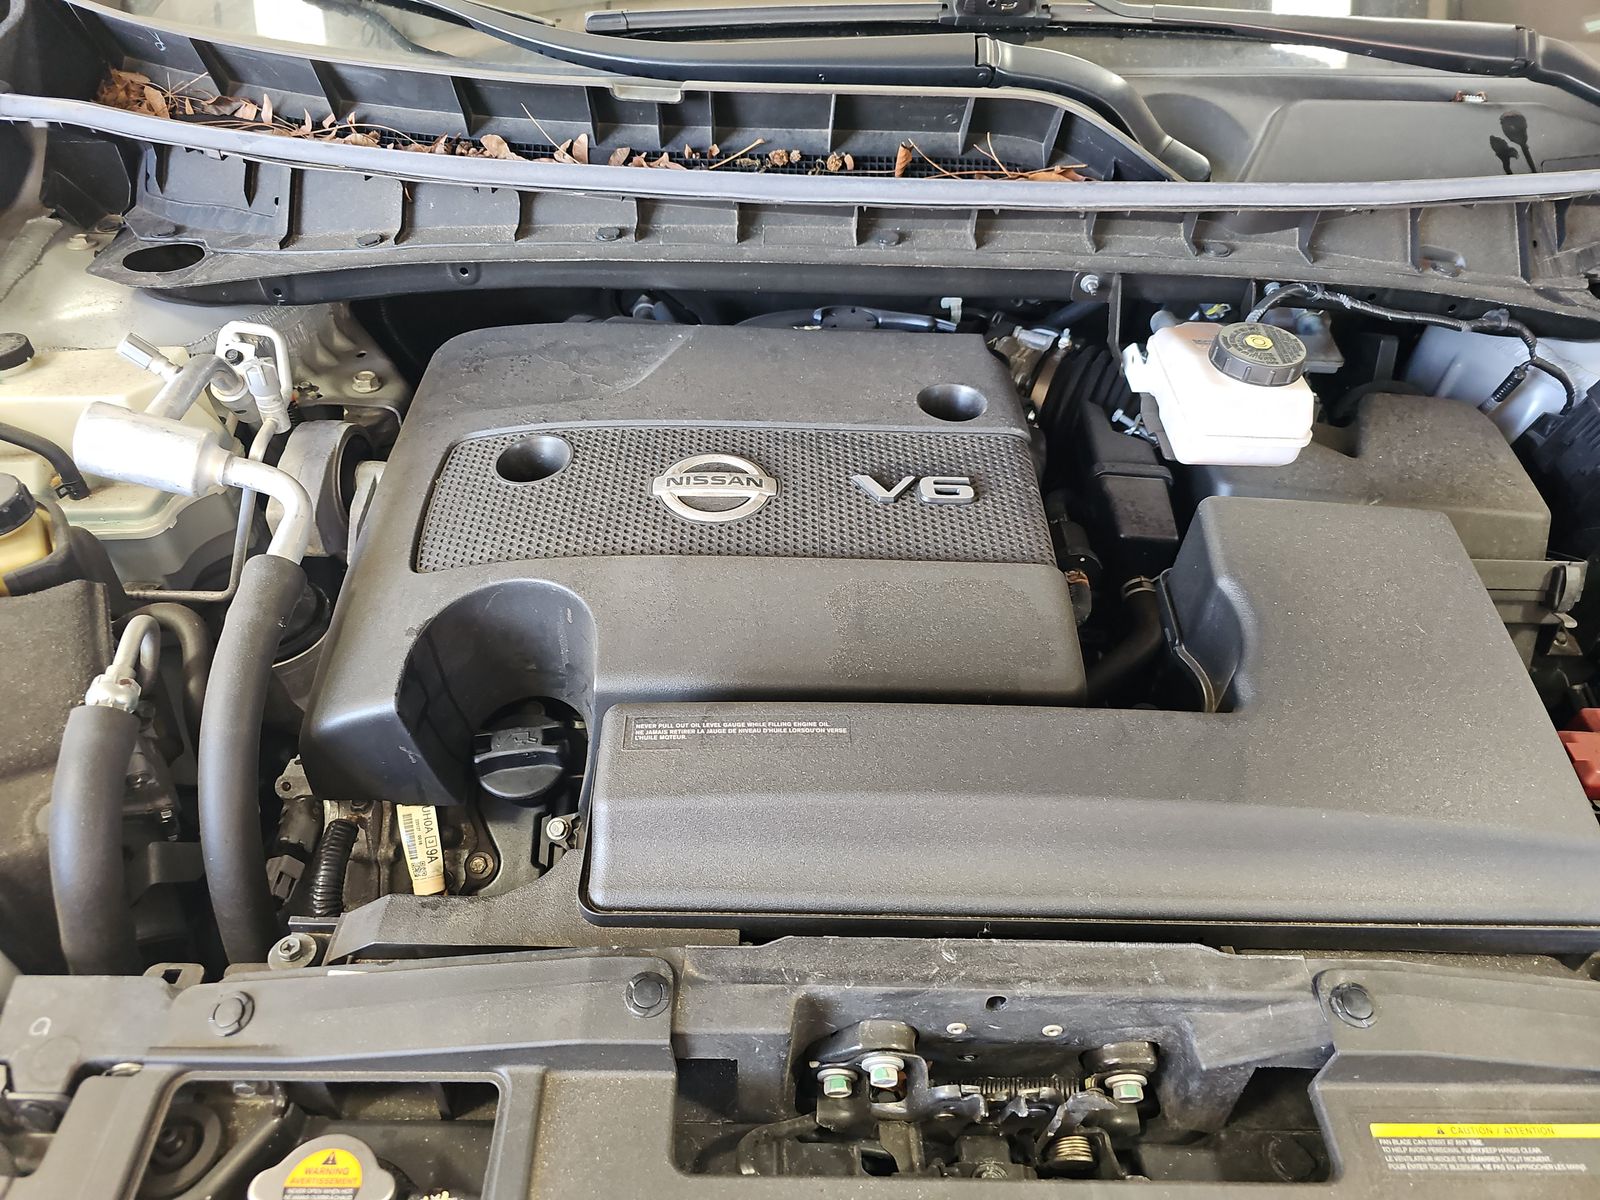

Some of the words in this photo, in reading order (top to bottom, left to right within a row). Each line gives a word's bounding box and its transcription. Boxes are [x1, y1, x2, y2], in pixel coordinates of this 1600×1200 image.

[665, 474, 764, 489] NISSAN
[850, 475, 975, 505] V6
[426, 848, 439, 864] 9A
